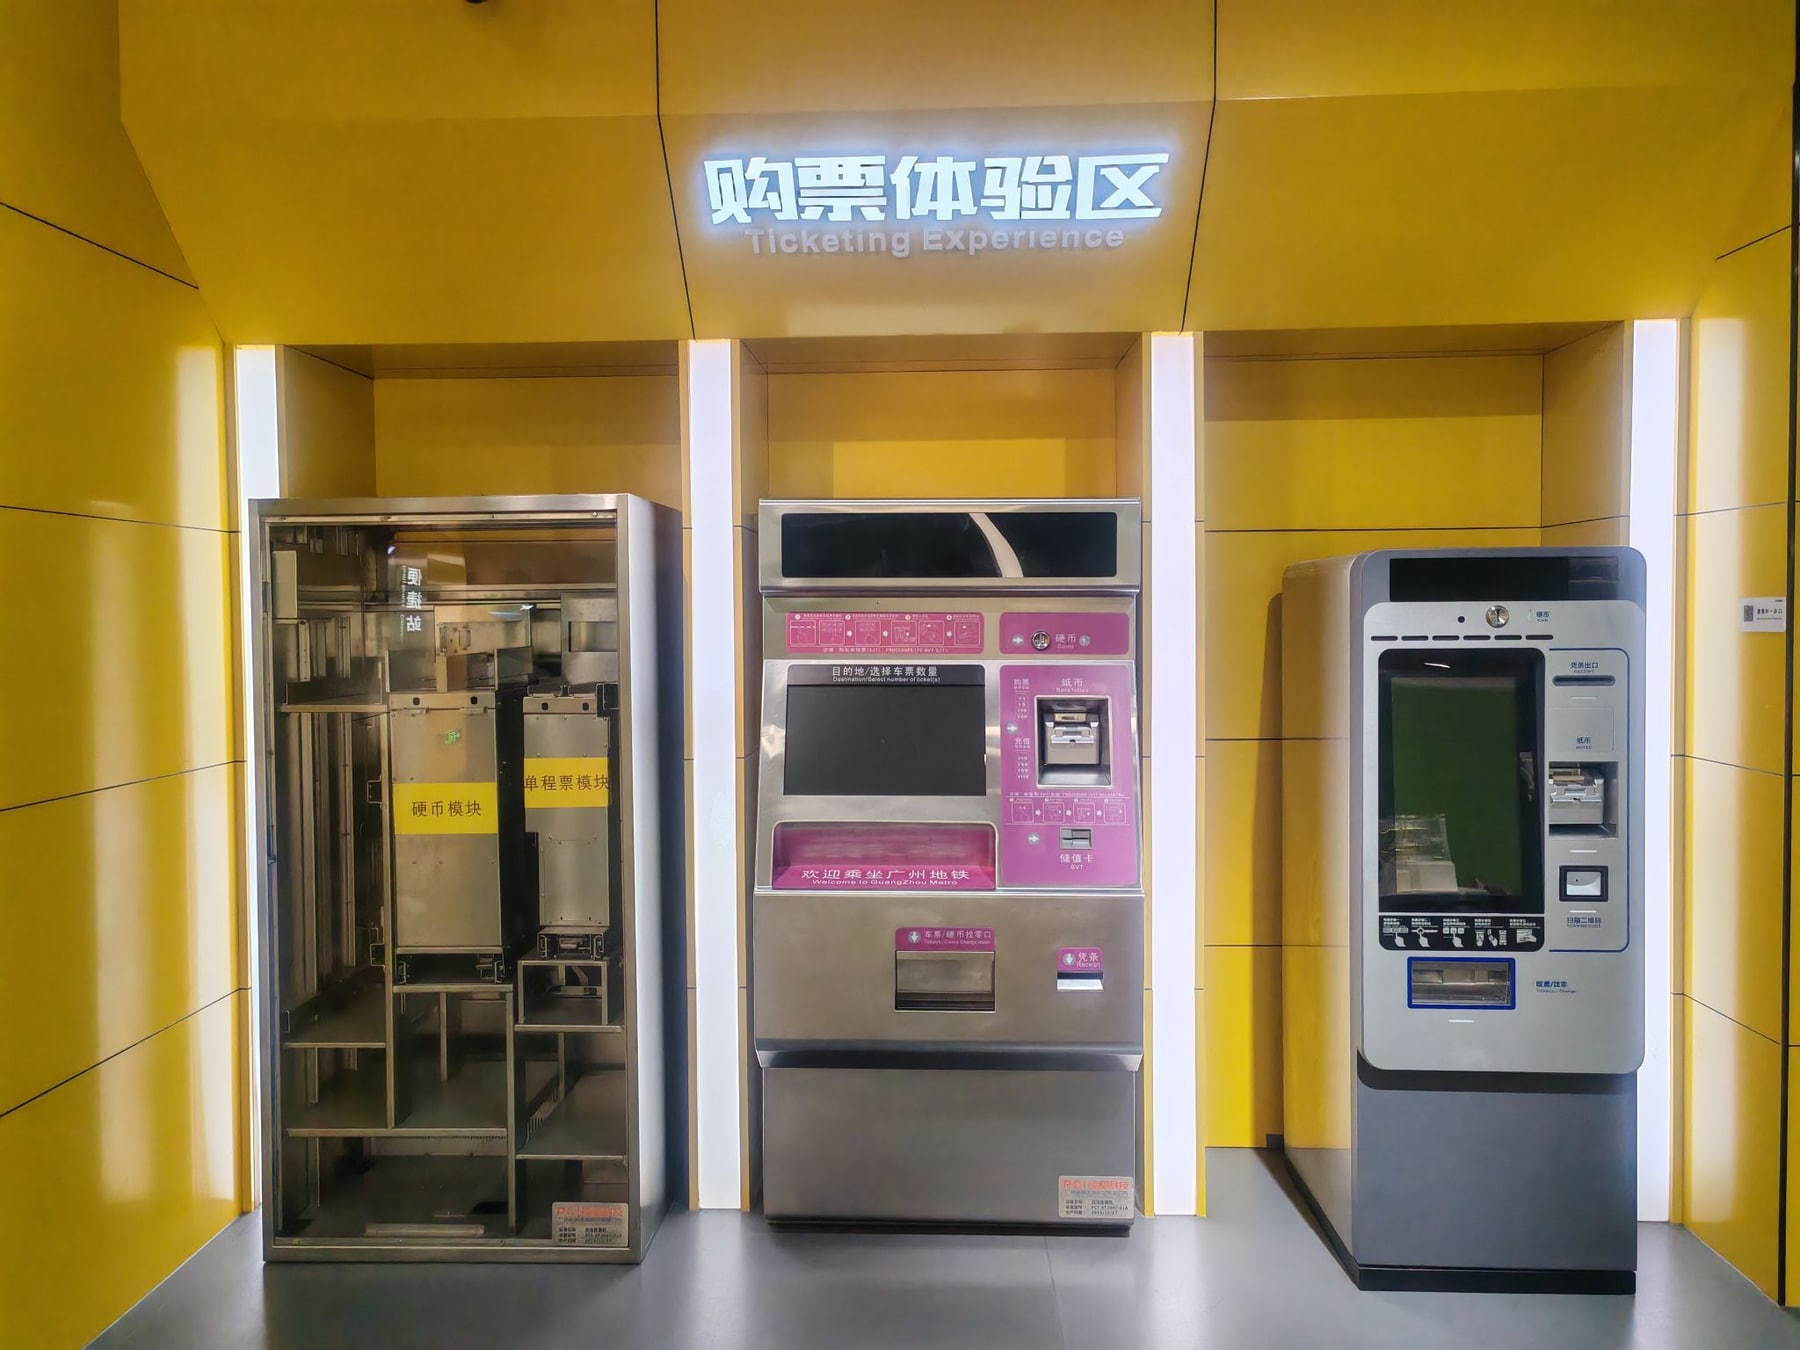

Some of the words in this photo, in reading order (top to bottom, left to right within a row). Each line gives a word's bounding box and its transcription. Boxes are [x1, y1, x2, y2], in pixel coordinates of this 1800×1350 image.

[704, 153, 1170, 225] 购票体验区
[745, 227, 911, 258] Ticketing
[923, 226, 1124, 256] Experience
[1055, 633, 1077, 643] 硬币
[832, 666, 938, 677] 目的地/选择车票数量
[916, 676, 940, 684] ticket(s)
[1061, 678, 1083, 687] 纸币
[523, 774, 609, 792] 单程票模块
[412, 800, 482, 817] 硬币模块
[1060, 853, 1095, 864] 储值卡
[801, 869, 970, 880] 欢迎乘坐广州地铁
[925, 930, 992, 939] 车票/硬币找零口
[1078, 952, 1099, 962] 凭条
